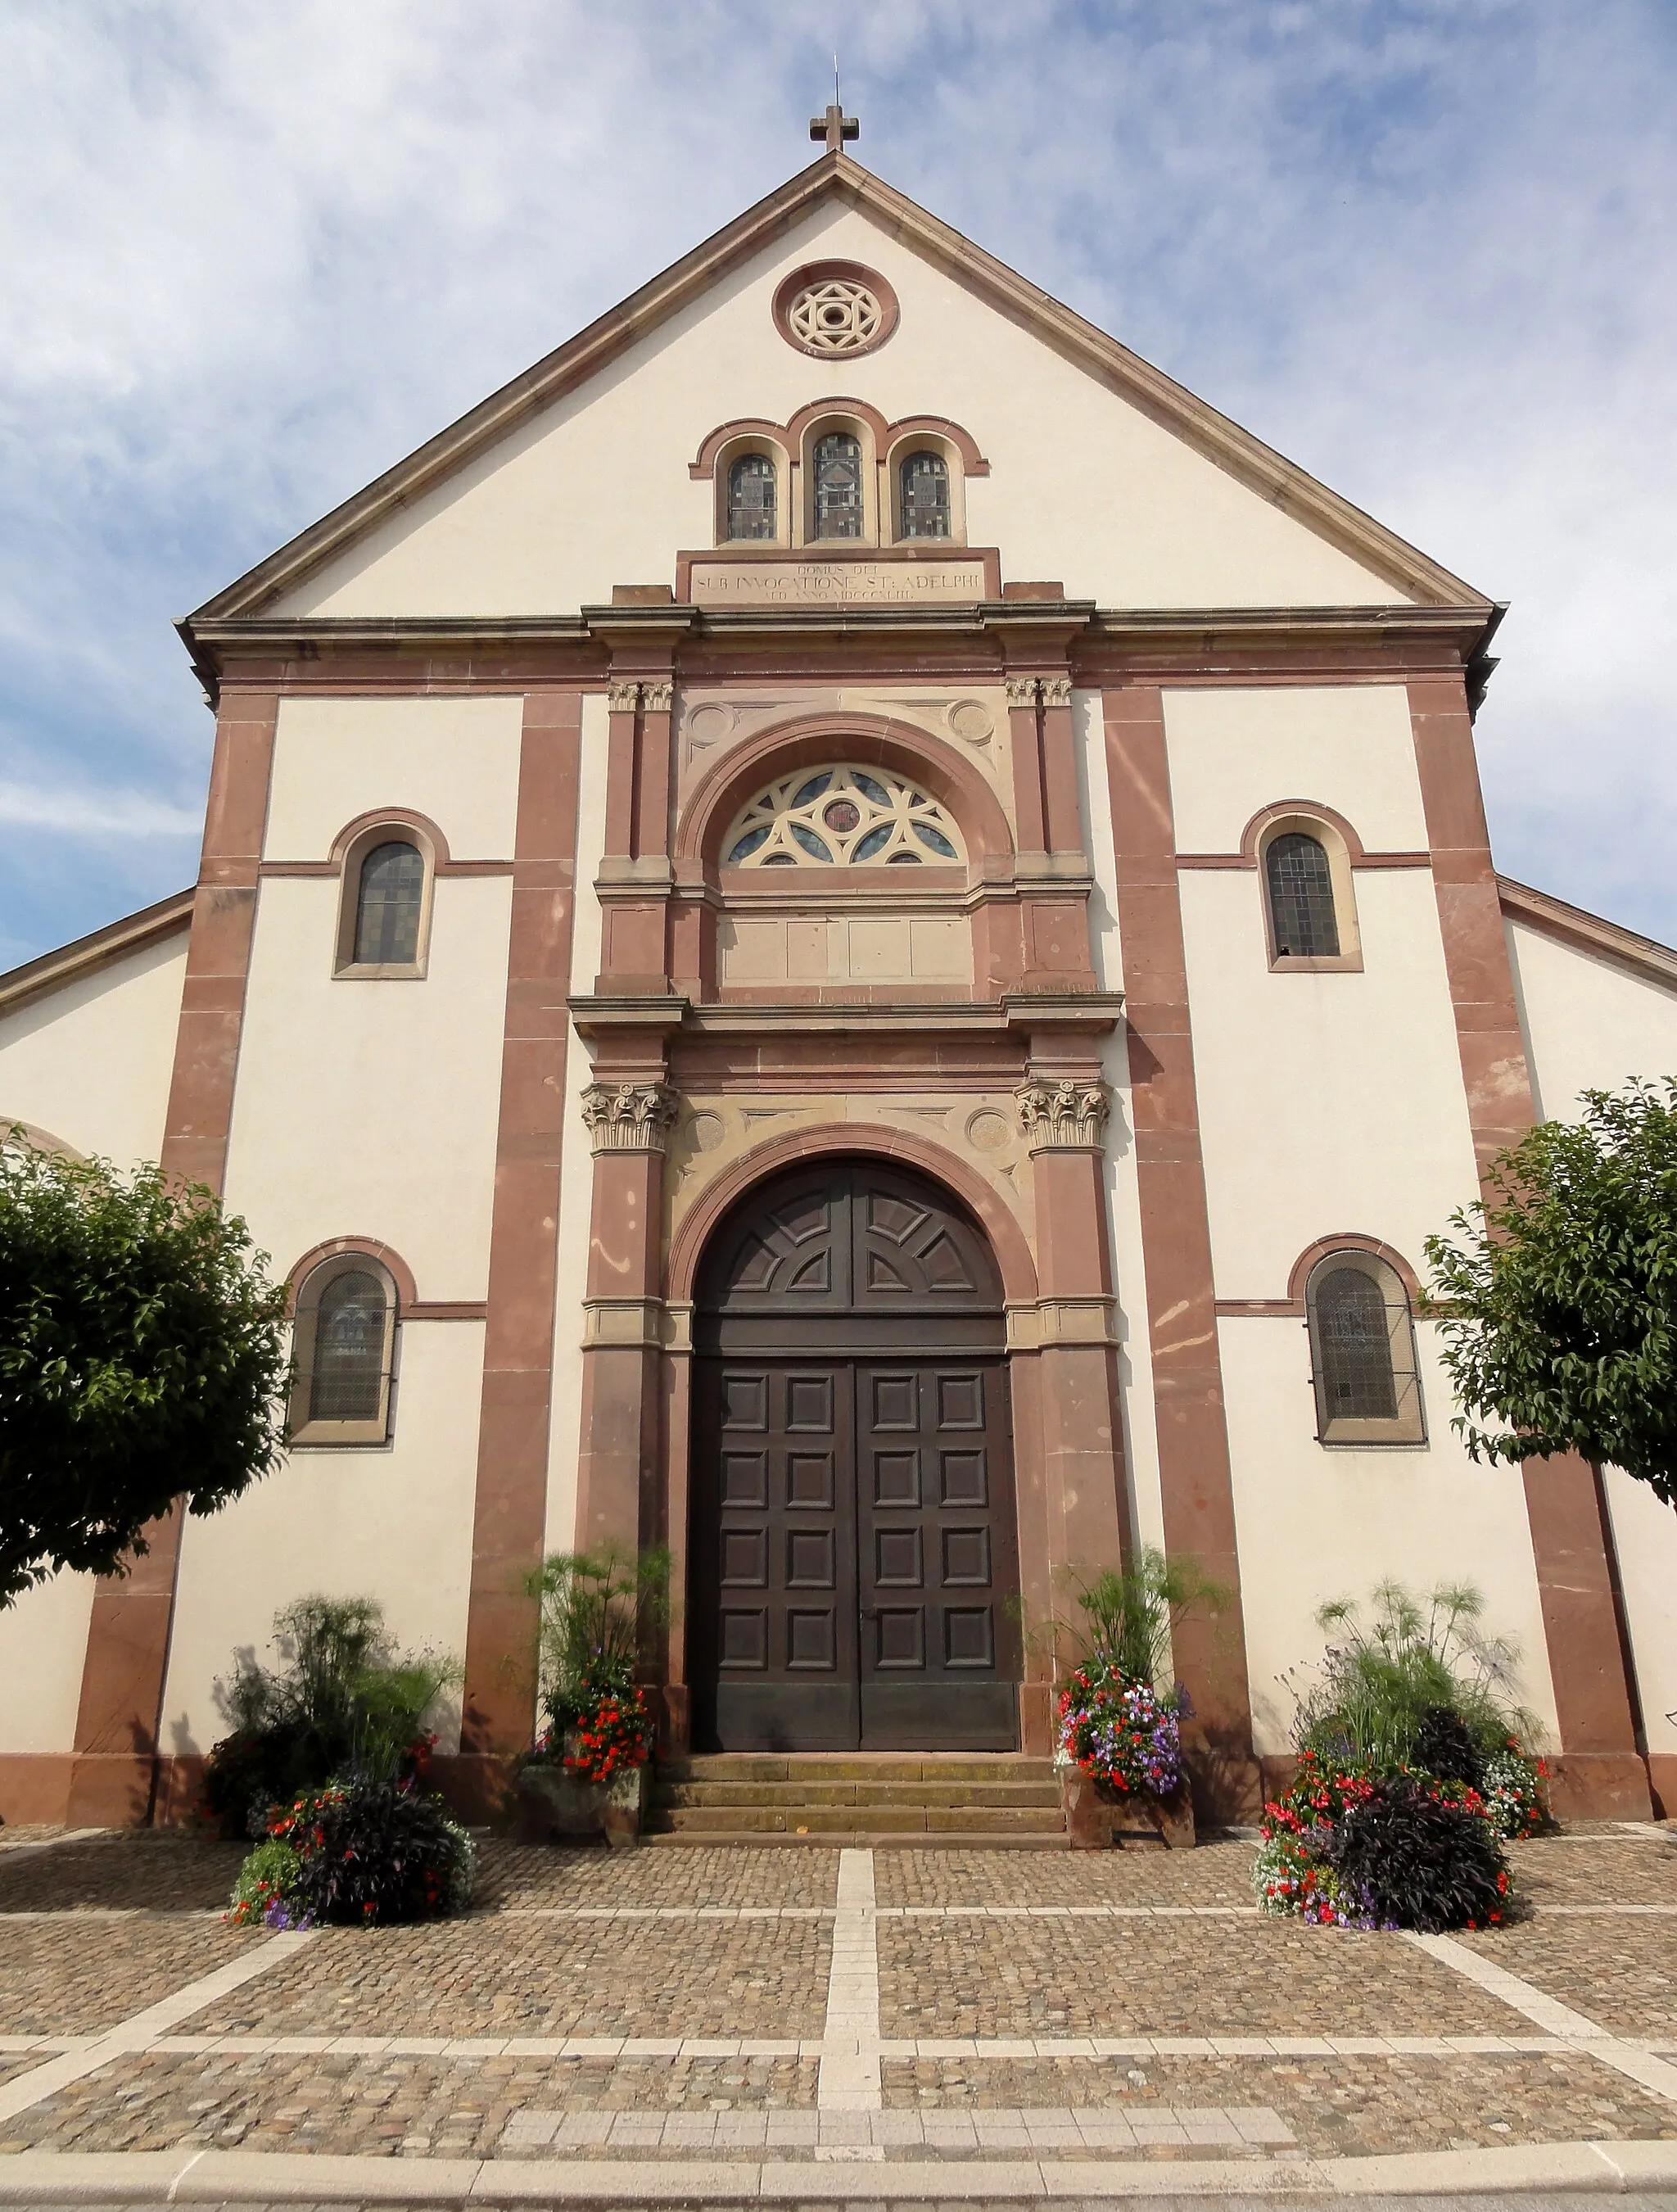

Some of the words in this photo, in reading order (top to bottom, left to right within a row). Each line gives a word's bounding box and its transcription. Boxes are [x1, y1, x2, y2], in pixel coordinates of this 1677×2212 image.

[797, 565, 843, 575] DOMUS
[736, 576, 857, 590] INVOCATIONE
[902, 575, 979, 590] ADELPHI
